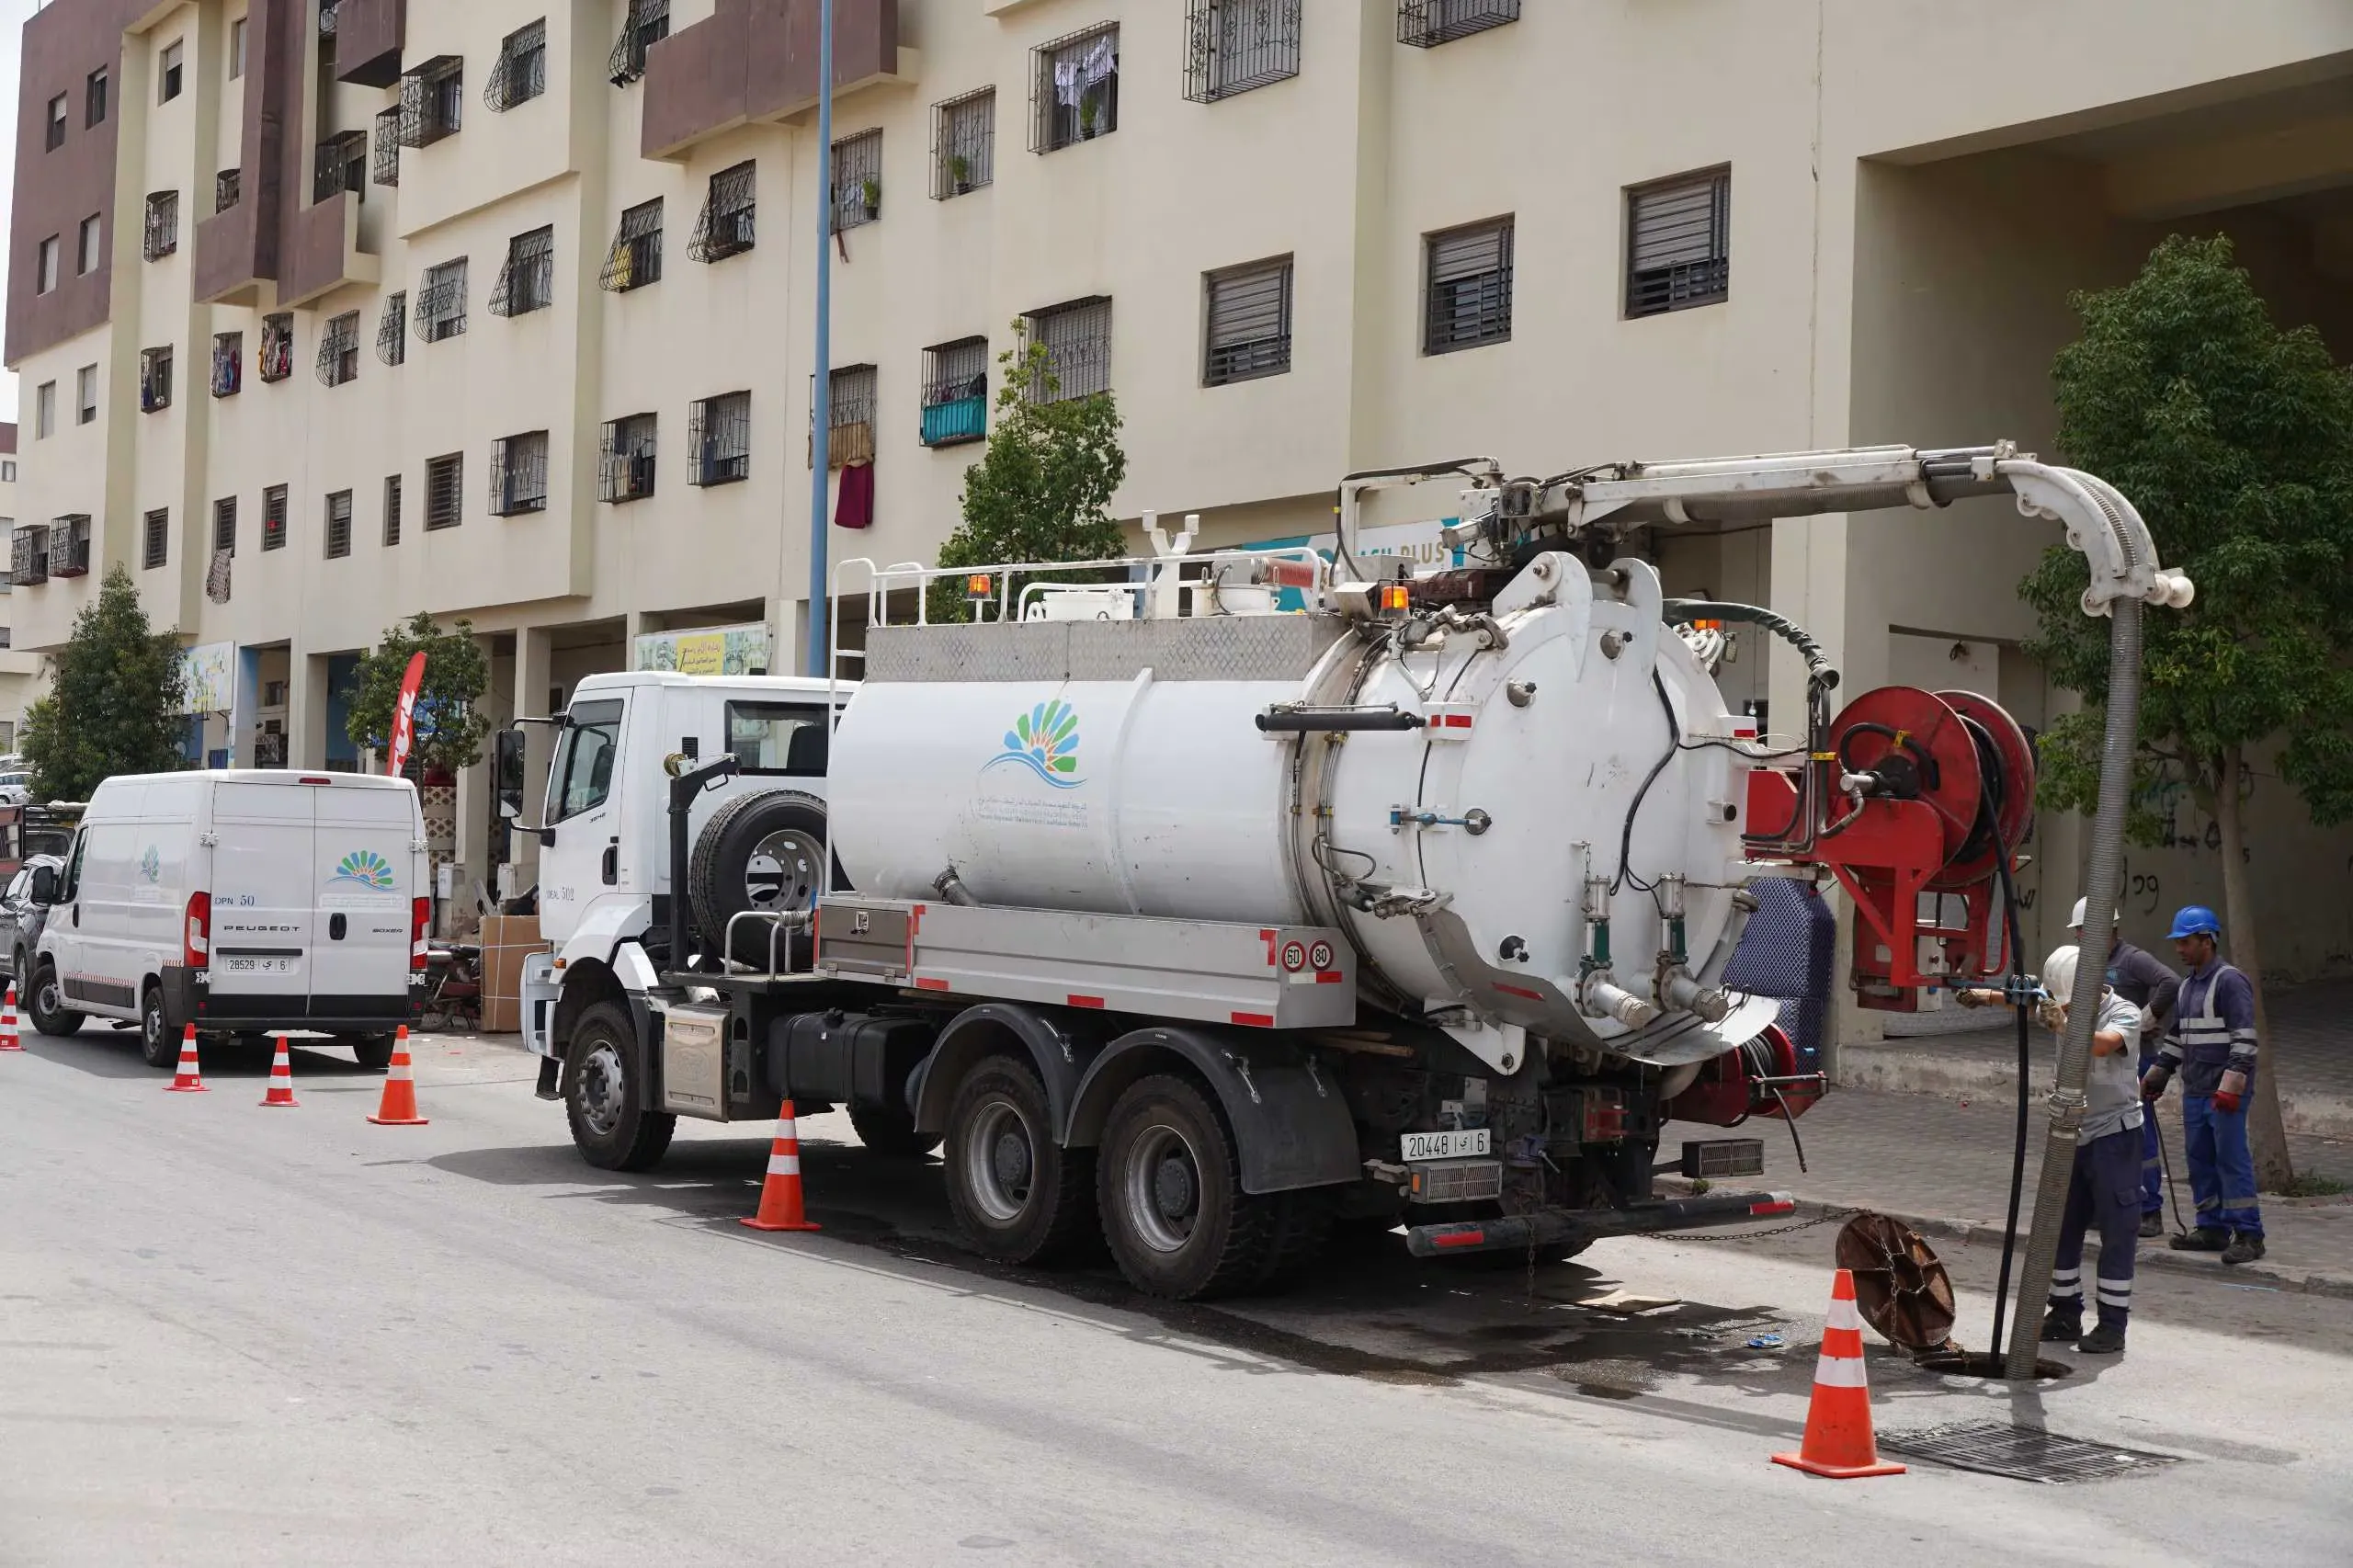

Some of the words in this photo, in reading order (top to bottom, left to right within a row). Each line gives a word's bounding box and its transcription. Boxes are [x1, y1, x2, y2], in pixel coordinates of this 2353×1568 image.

[1287, 949, 1299, 964] 60
[1315, 948, 1326, 963] 80
[230, 960, 255, 970] 28529
[279, 960, 286, 971] 6
[1409, 1135, 1449, 1157] 20448
[1477, 1132, 1484, 1153] 6
